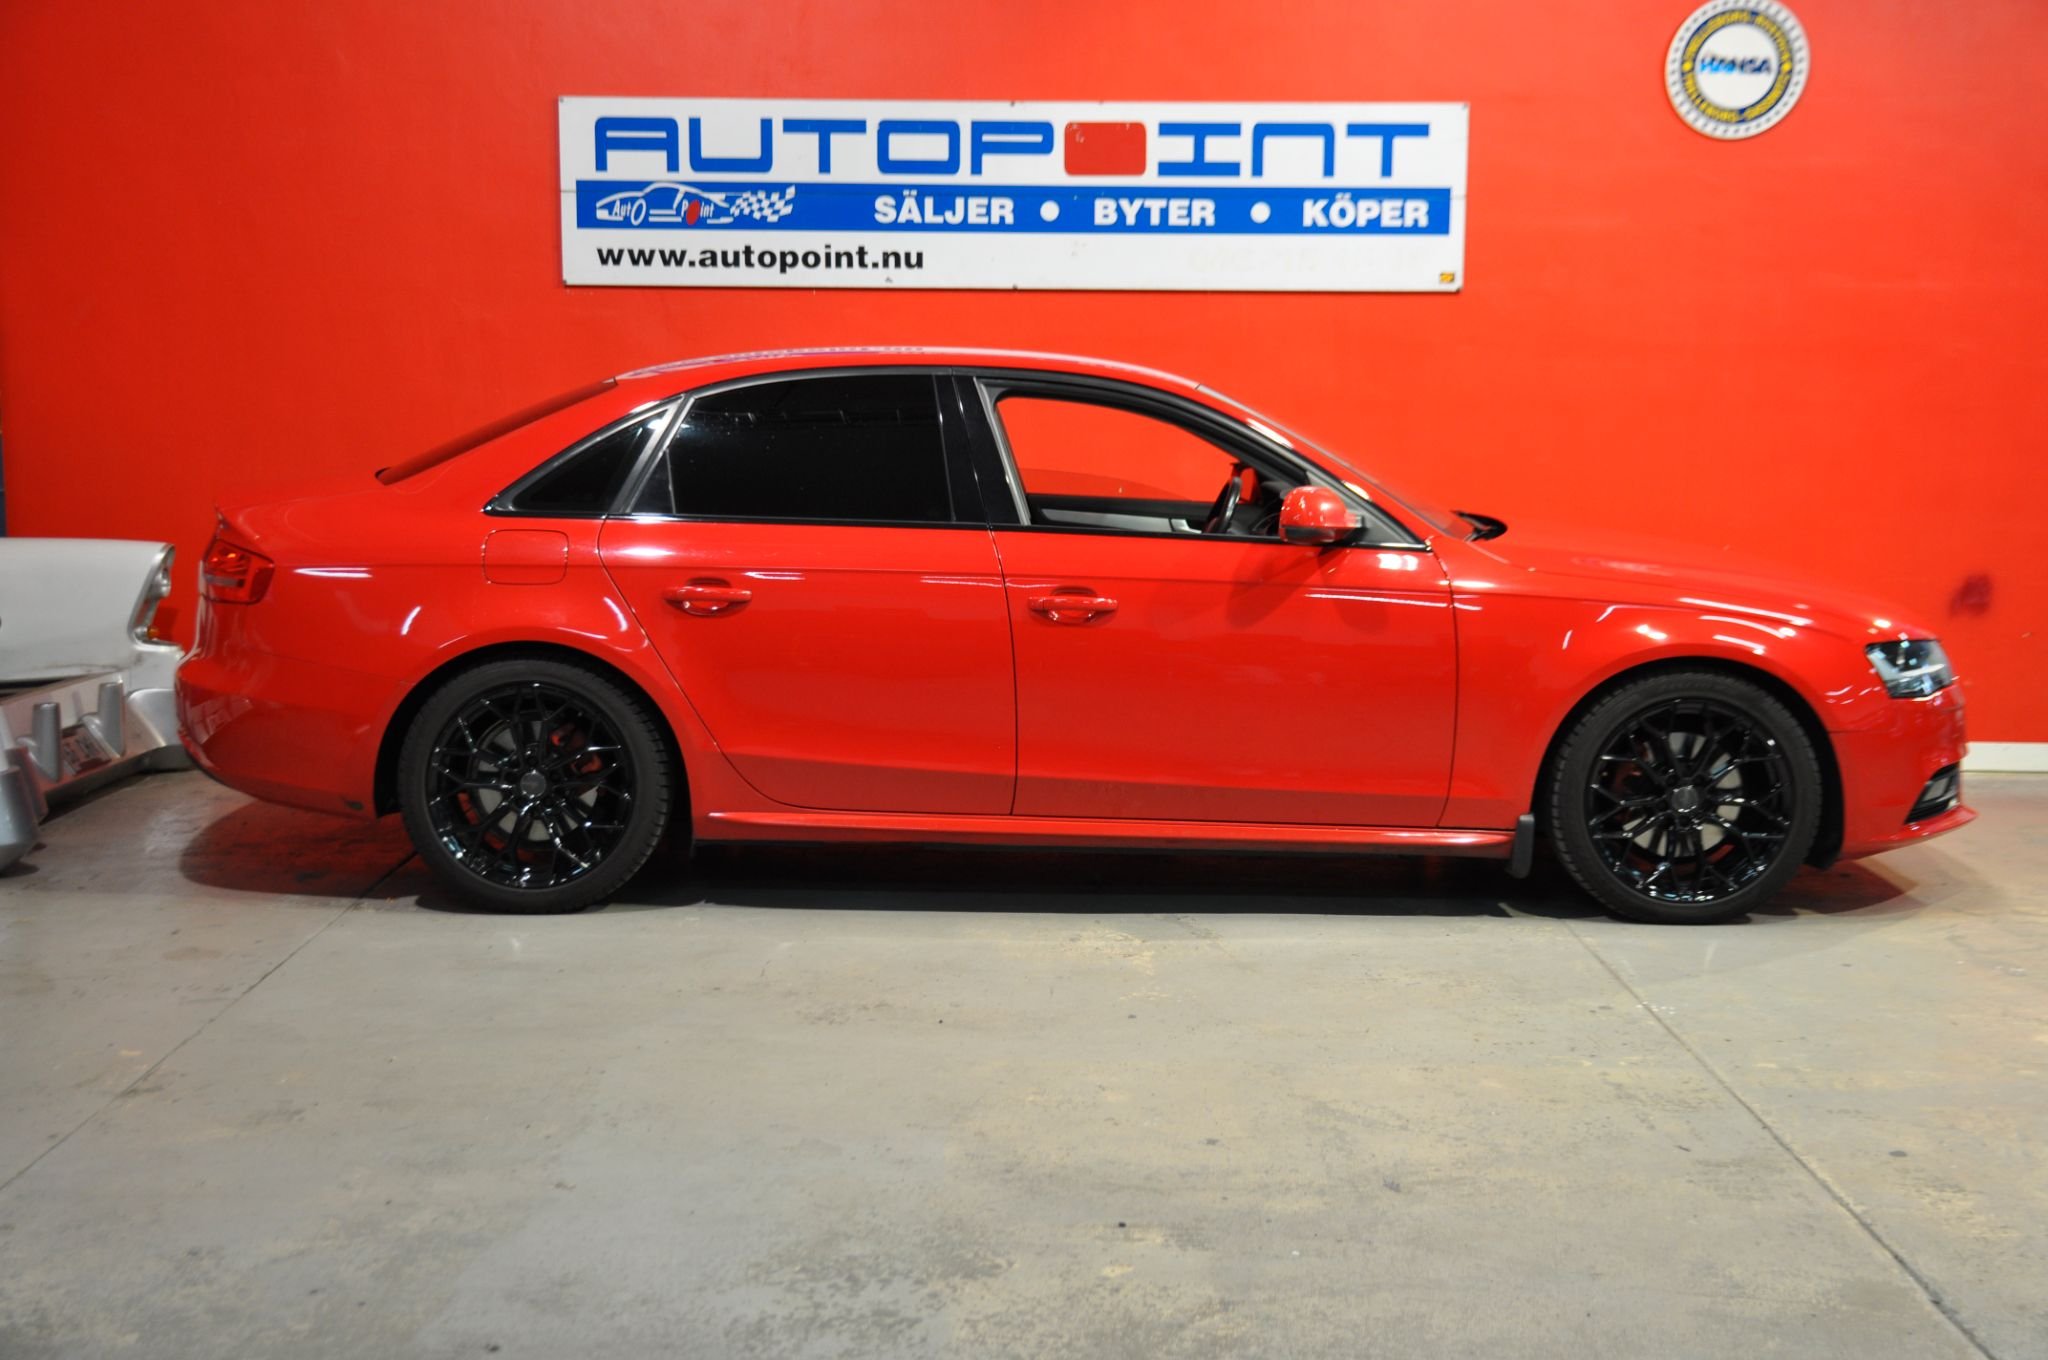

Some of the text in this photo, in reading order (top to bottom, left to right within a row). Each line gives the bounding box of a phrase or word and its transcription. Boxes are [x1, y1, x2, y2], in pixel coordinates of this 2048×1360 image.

[594, 117, 1430, 177] AUTOPOINT
[874, 189, 1429, 228] SÄLJER BYTER KÖPER
[597, 245, 924, 273] www.autopoint.nu
